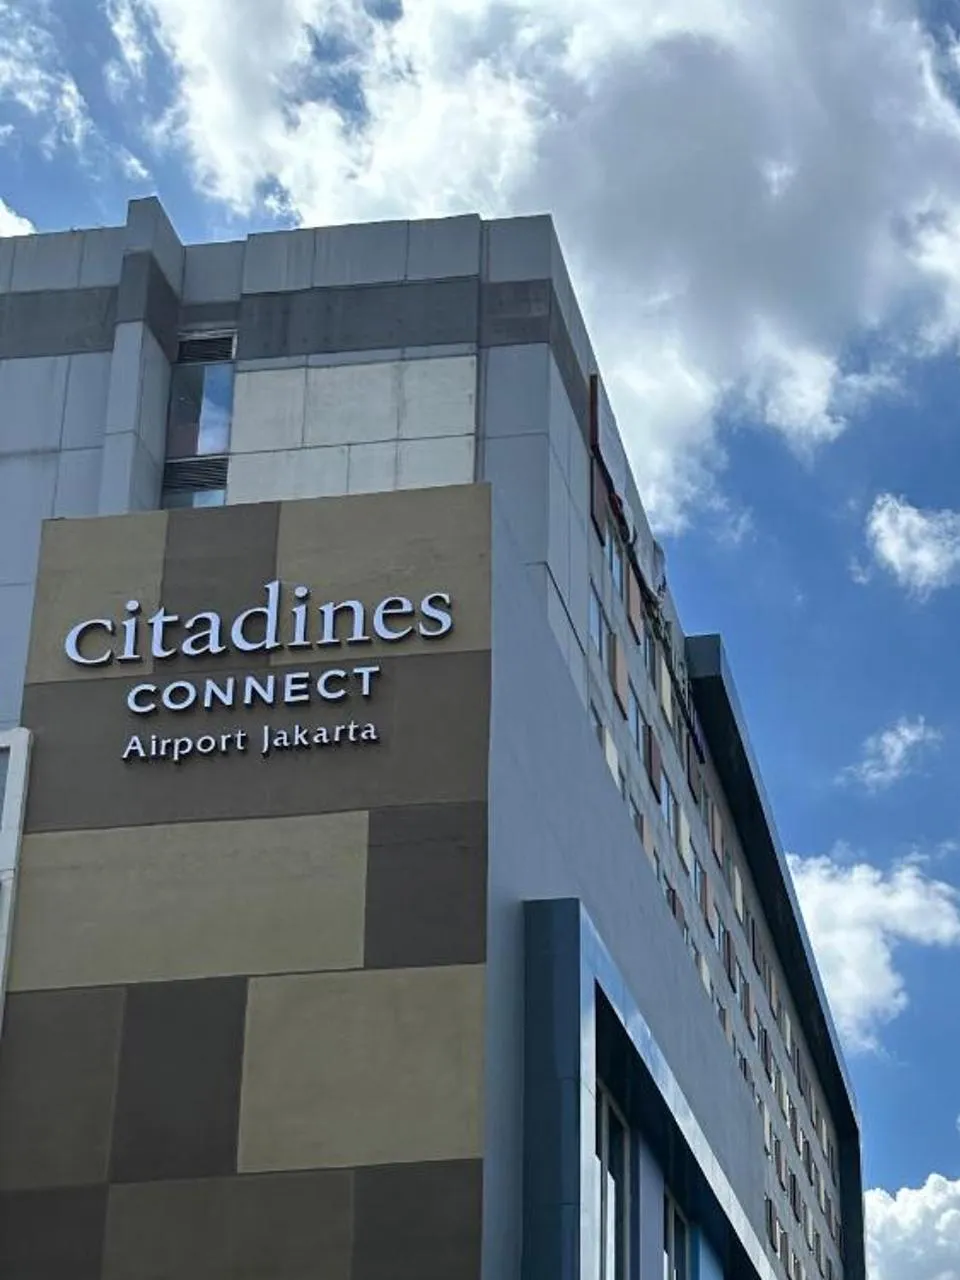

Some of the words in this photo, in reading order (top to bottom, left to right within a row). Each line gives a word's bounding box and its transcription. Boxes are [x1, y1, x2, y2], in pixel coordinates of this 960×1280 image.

[63, 580, 454, 666] citadines
[127, 666, 381, 714] CONNECT
[121, 728, 247, 762] Airport
[259, 719, 379, 754] Jakarta
